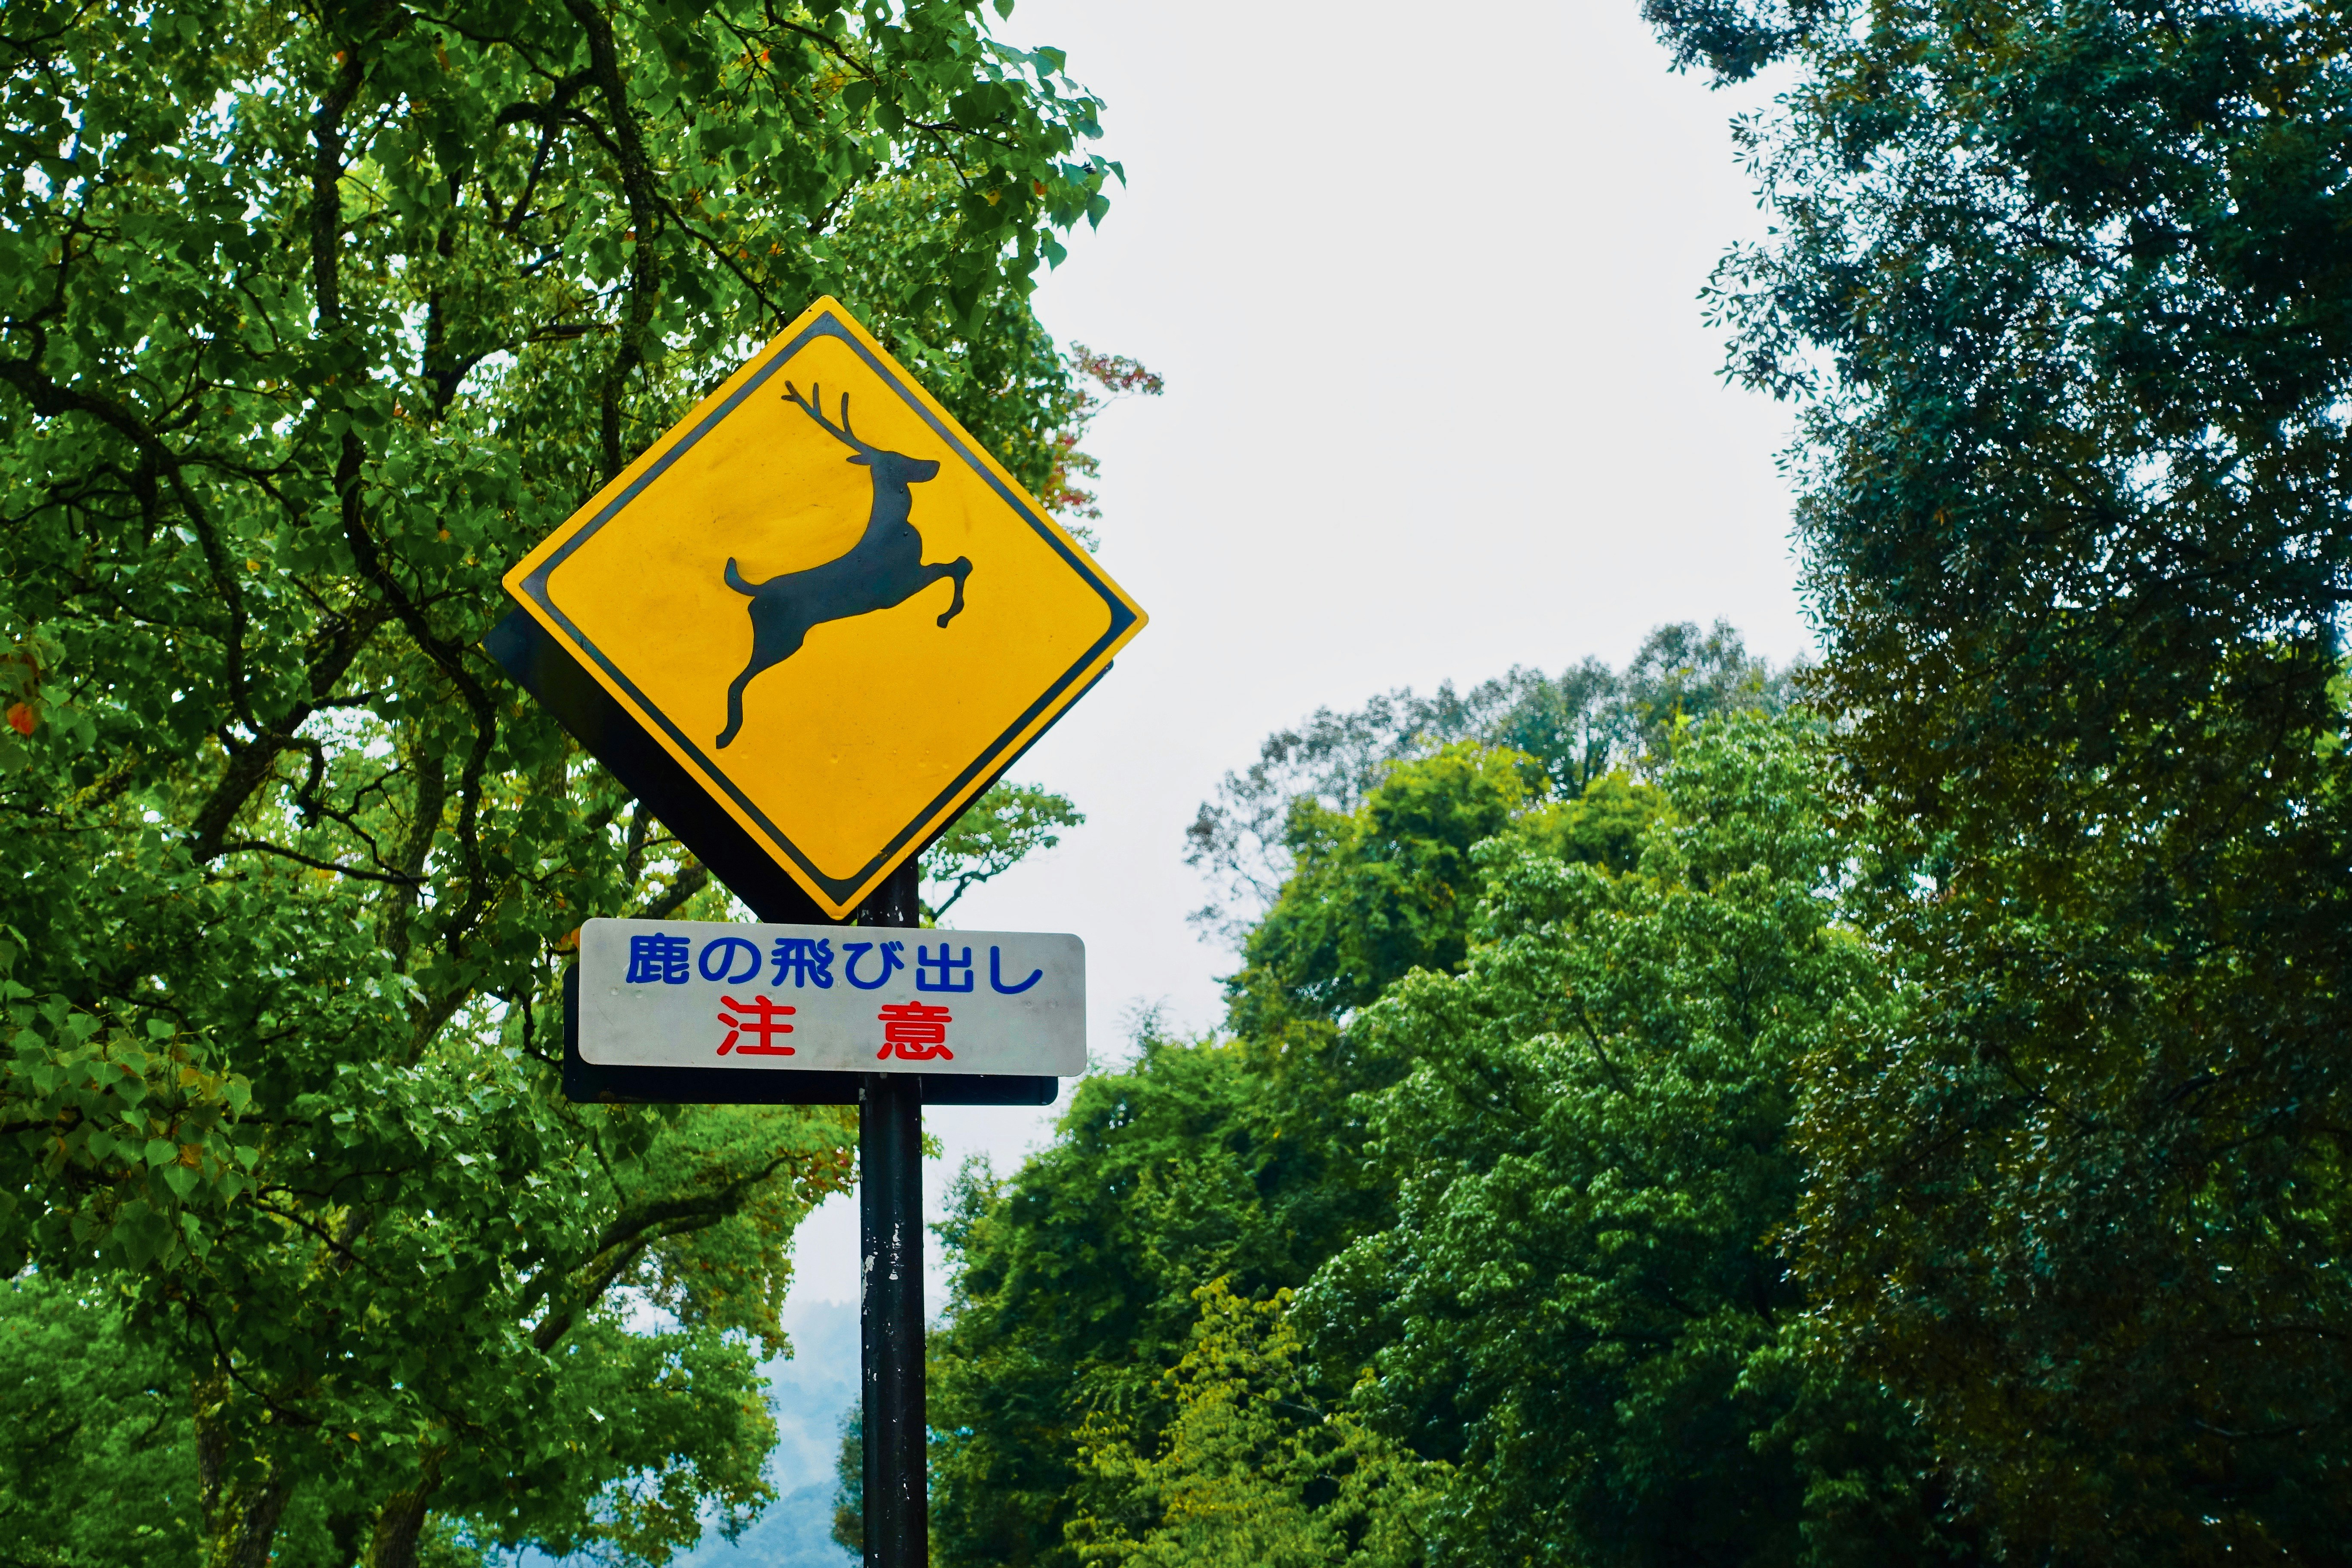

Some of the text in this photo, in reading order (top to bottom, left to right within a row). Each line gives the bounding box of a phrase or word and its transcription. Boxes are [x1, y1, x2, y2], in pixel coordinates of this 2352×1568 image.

[626, 932, 1043, 995] 鹿の飛び出し
